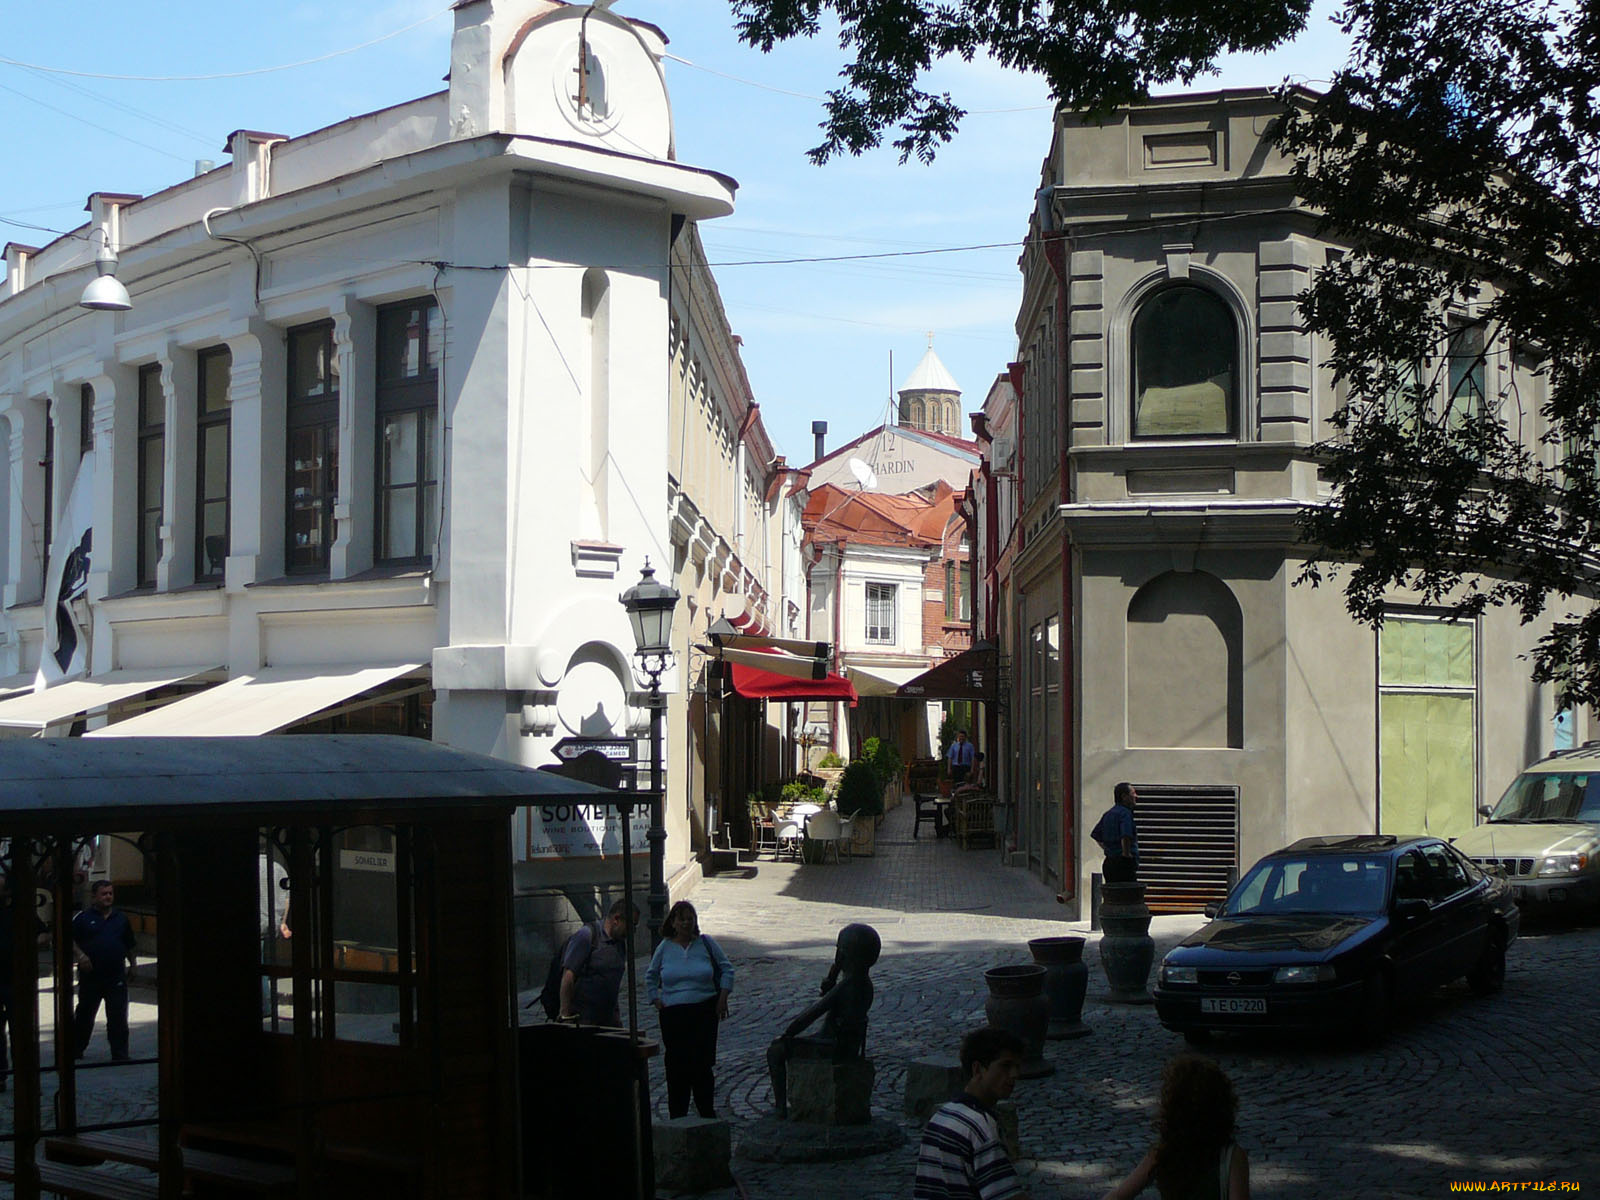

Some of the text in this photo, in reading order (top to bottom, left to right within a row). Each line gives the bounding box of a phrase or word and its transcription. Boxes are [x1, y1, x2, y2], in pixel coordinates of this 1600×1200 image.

[882, 433, 895, 452] 12
[871, 460, 915, 475] HARDIN
[542, 803, 649, 822] SOMELR
[571, 824, 617, 832] BOUTIQUE
[1209, 1000, 1264, 1012] TEO-220
